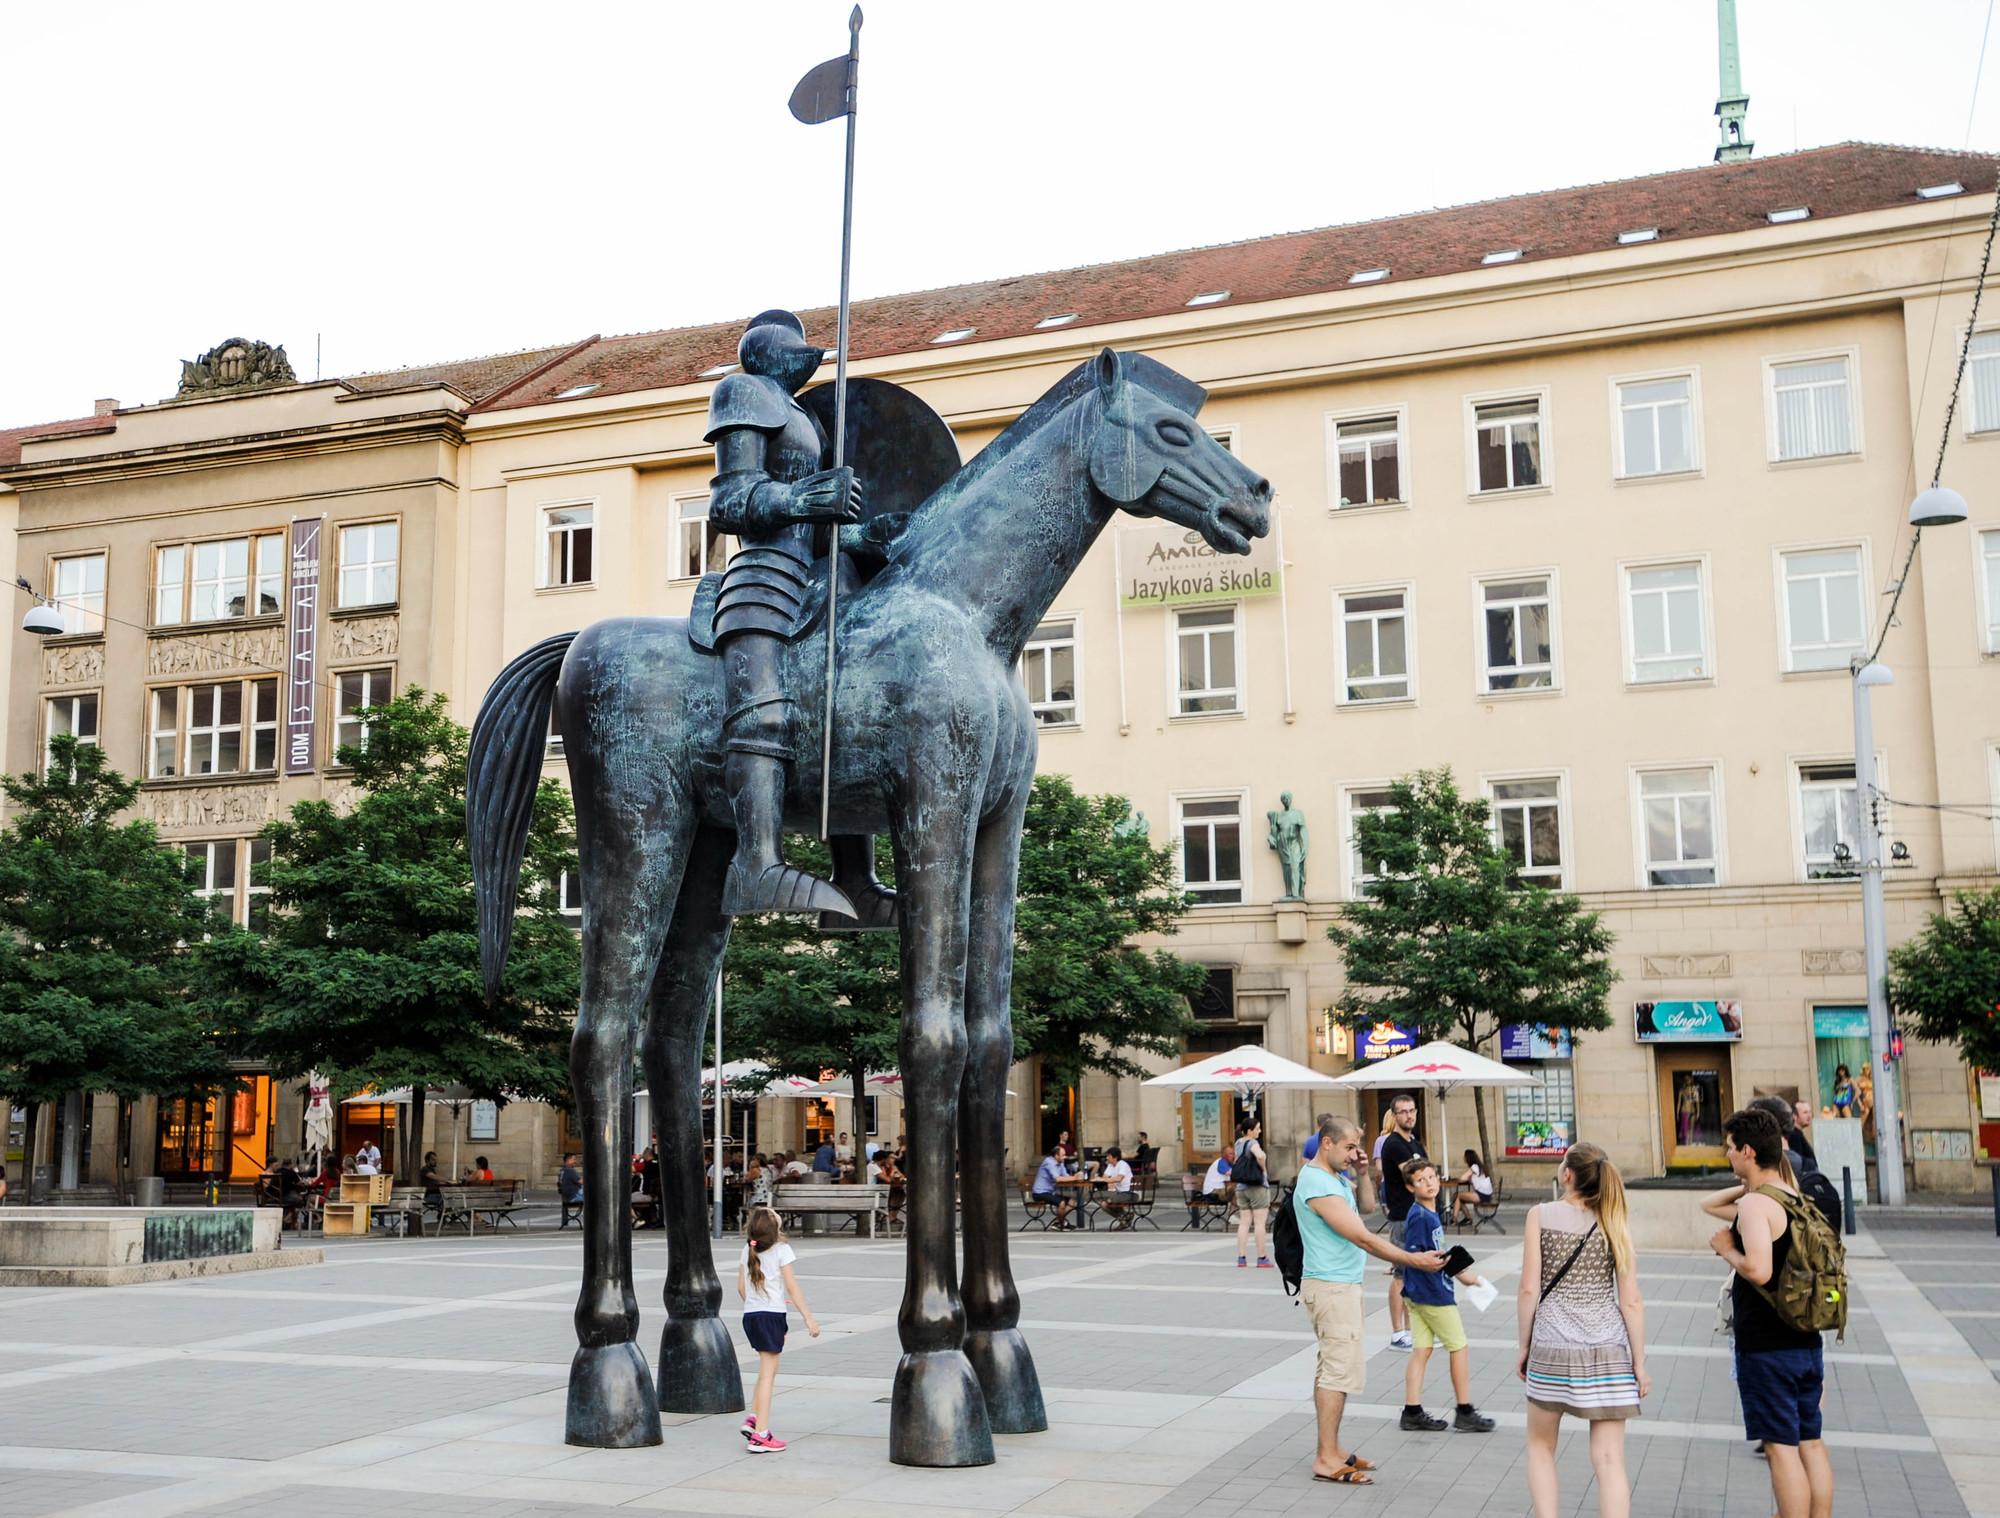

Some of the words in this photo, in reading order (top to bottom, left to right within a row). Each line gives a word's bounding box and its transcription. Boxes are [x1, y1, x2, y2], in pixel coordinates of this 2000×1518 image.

[1128, 571, 1213, 602] Jazyková
[1220, 568, 1272, 592] škola
[293, 596, 313, 713] SCALA
